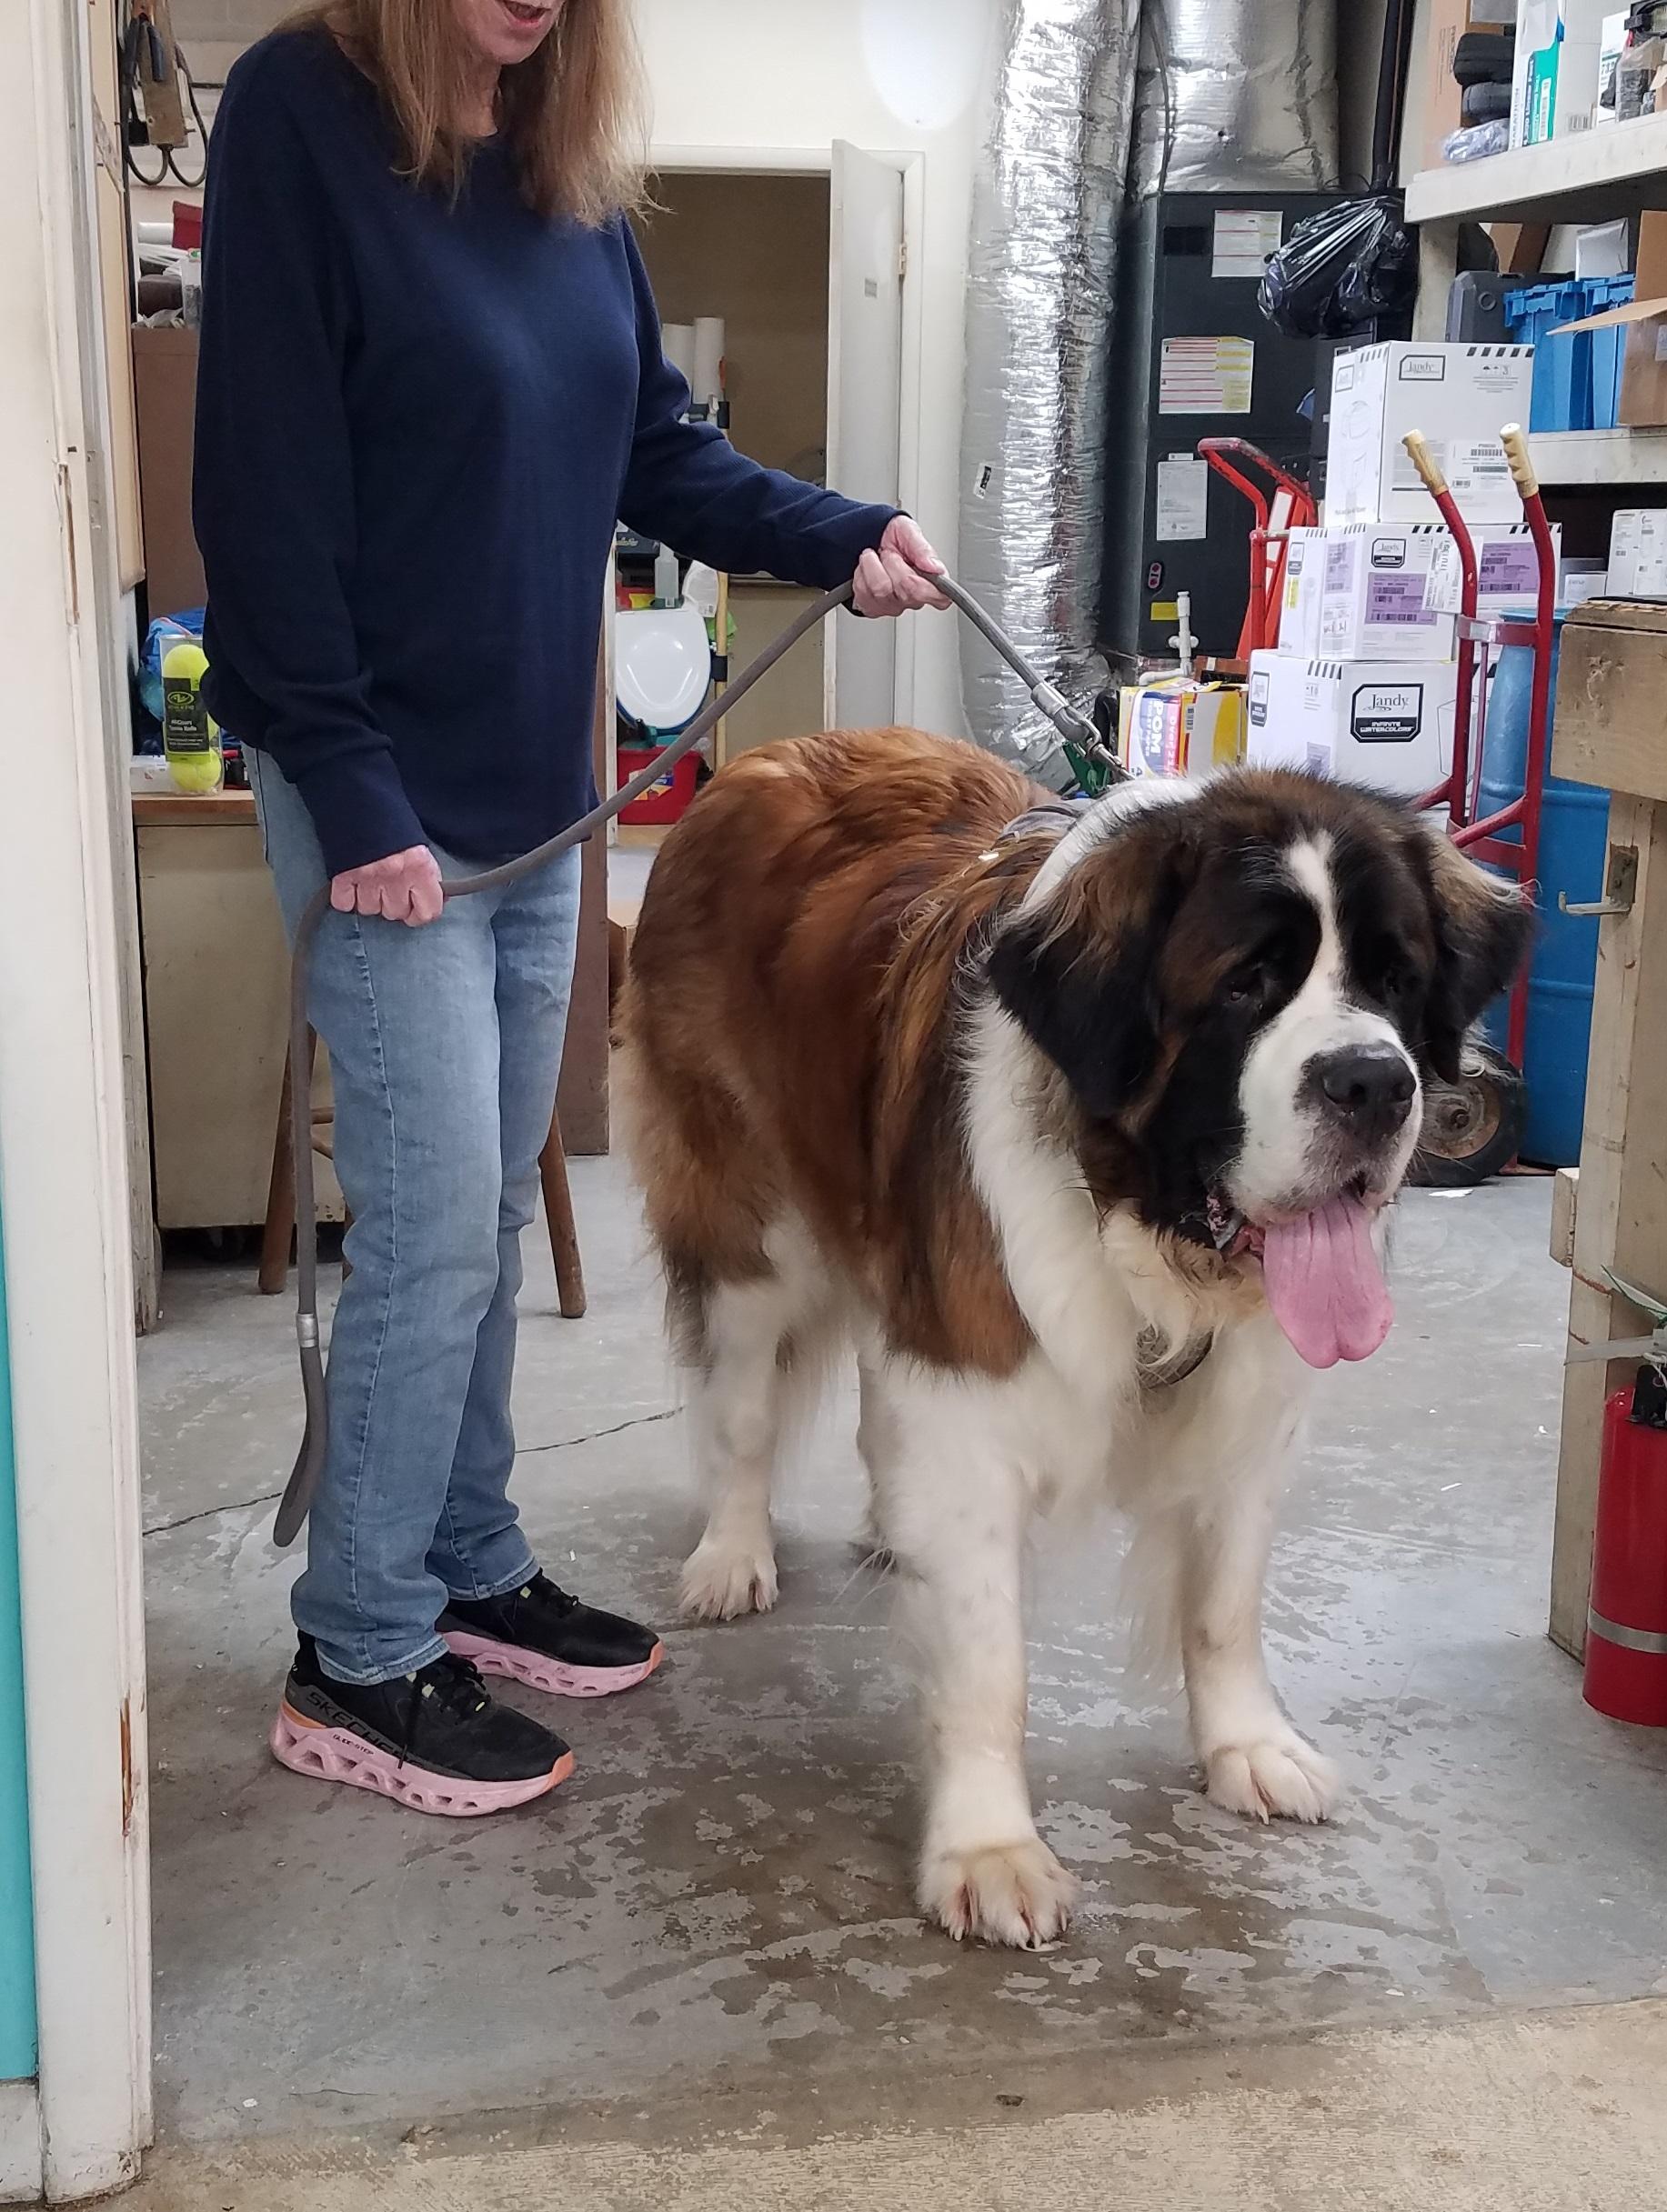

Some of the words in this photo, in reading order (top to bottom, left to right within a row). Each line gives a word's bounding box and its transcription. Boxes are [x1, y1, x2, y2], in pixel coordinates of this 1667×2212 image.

[1408, 361, 1434, 373] Jandy
[1366, 693, 1410, 711] Jandy
[1150, 700, 1164, 755] POM
[1168, 716, 1177, 747] Over
